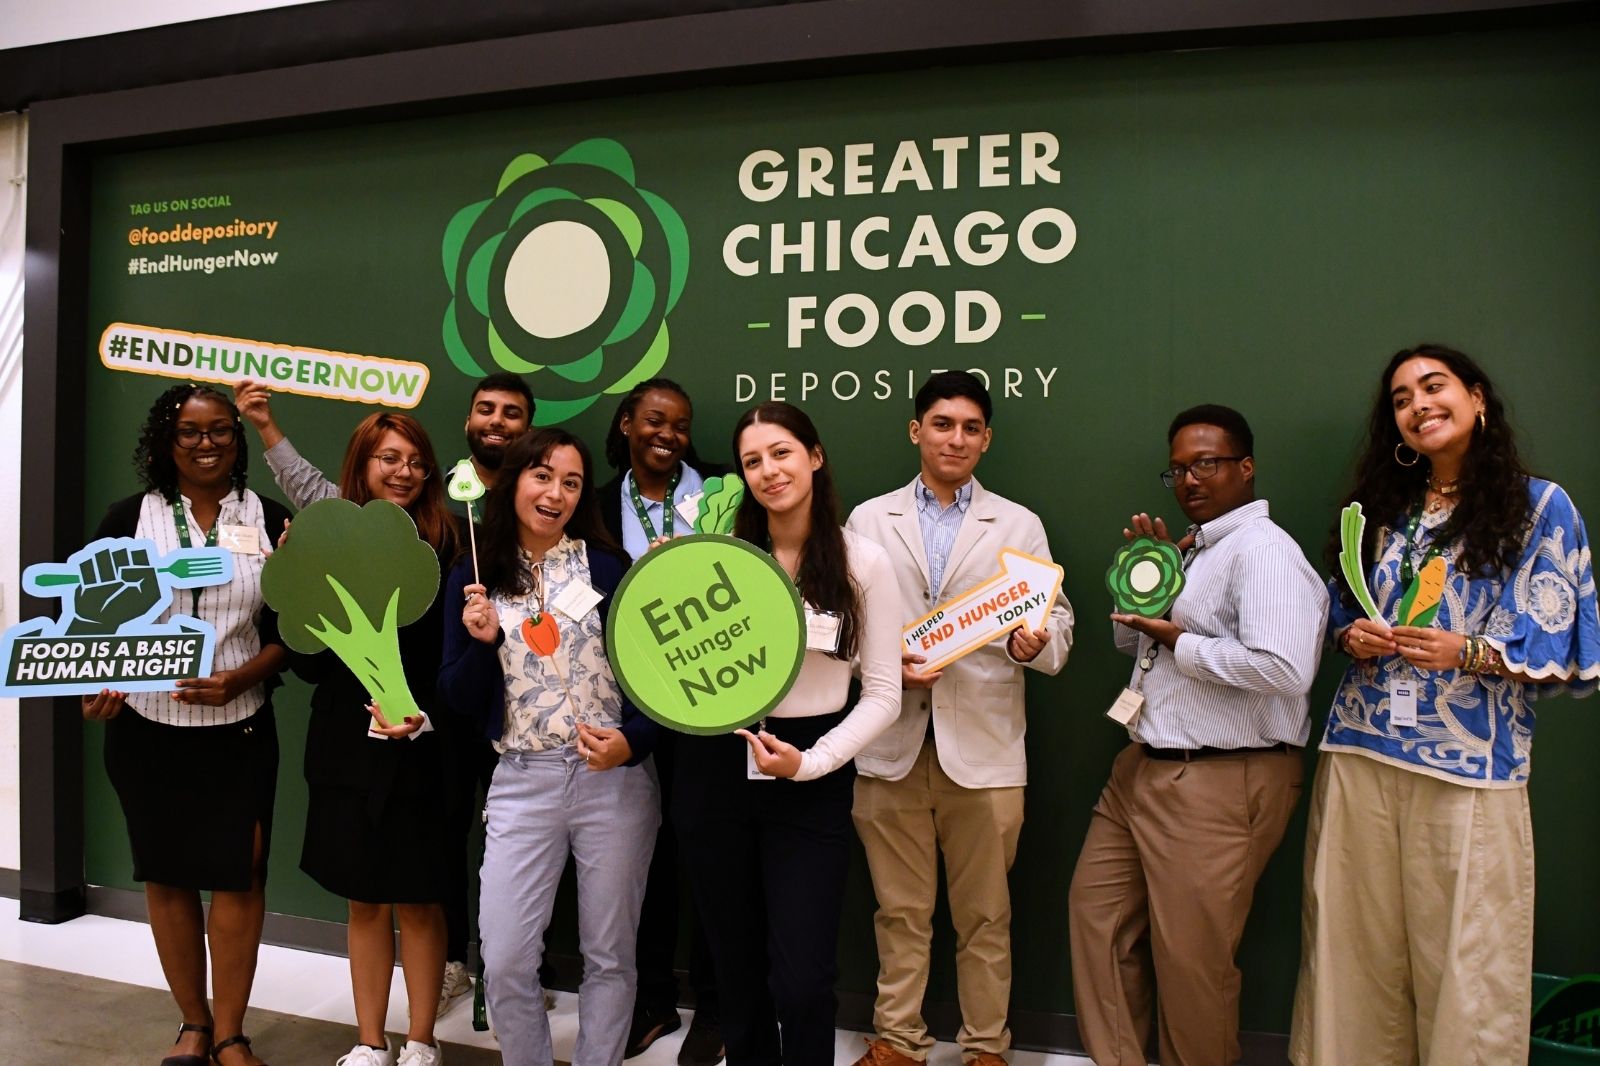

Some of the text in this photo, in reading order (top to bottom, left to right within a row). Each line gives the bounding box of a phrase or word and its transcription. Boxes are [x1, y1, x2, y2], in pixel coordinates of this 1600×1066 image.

[738, 131, 1061, 203] GREATER
[130, 195, 231, 215] TAG US ON SOCIAL
[129, 219, 278, 245] @fooddepository
[722, 207, 1077, 277] CHICAGO
[128, 249, 279, 275] #EndHungerNow
[787, 290, 1002, 348] FOOD
[108, 334, 420, 397] #ENDHUNGERNOW
[735, 367, 1058, 403] DEPOSIRY
[640, 560, 742, 646] End
[921, 581, 1030, 650] END HUNGER
[996, 592, 1047, 625] TODAY!
[21, 639, 196, 659] FOOD IS A BASIC
[664, 615, 751, 672] Hunger
[905, 611, 944, 646] I HELPED
[16, 657, 193, 680] HUMAN RIGHT
[678, 645, 767, 708] Now
